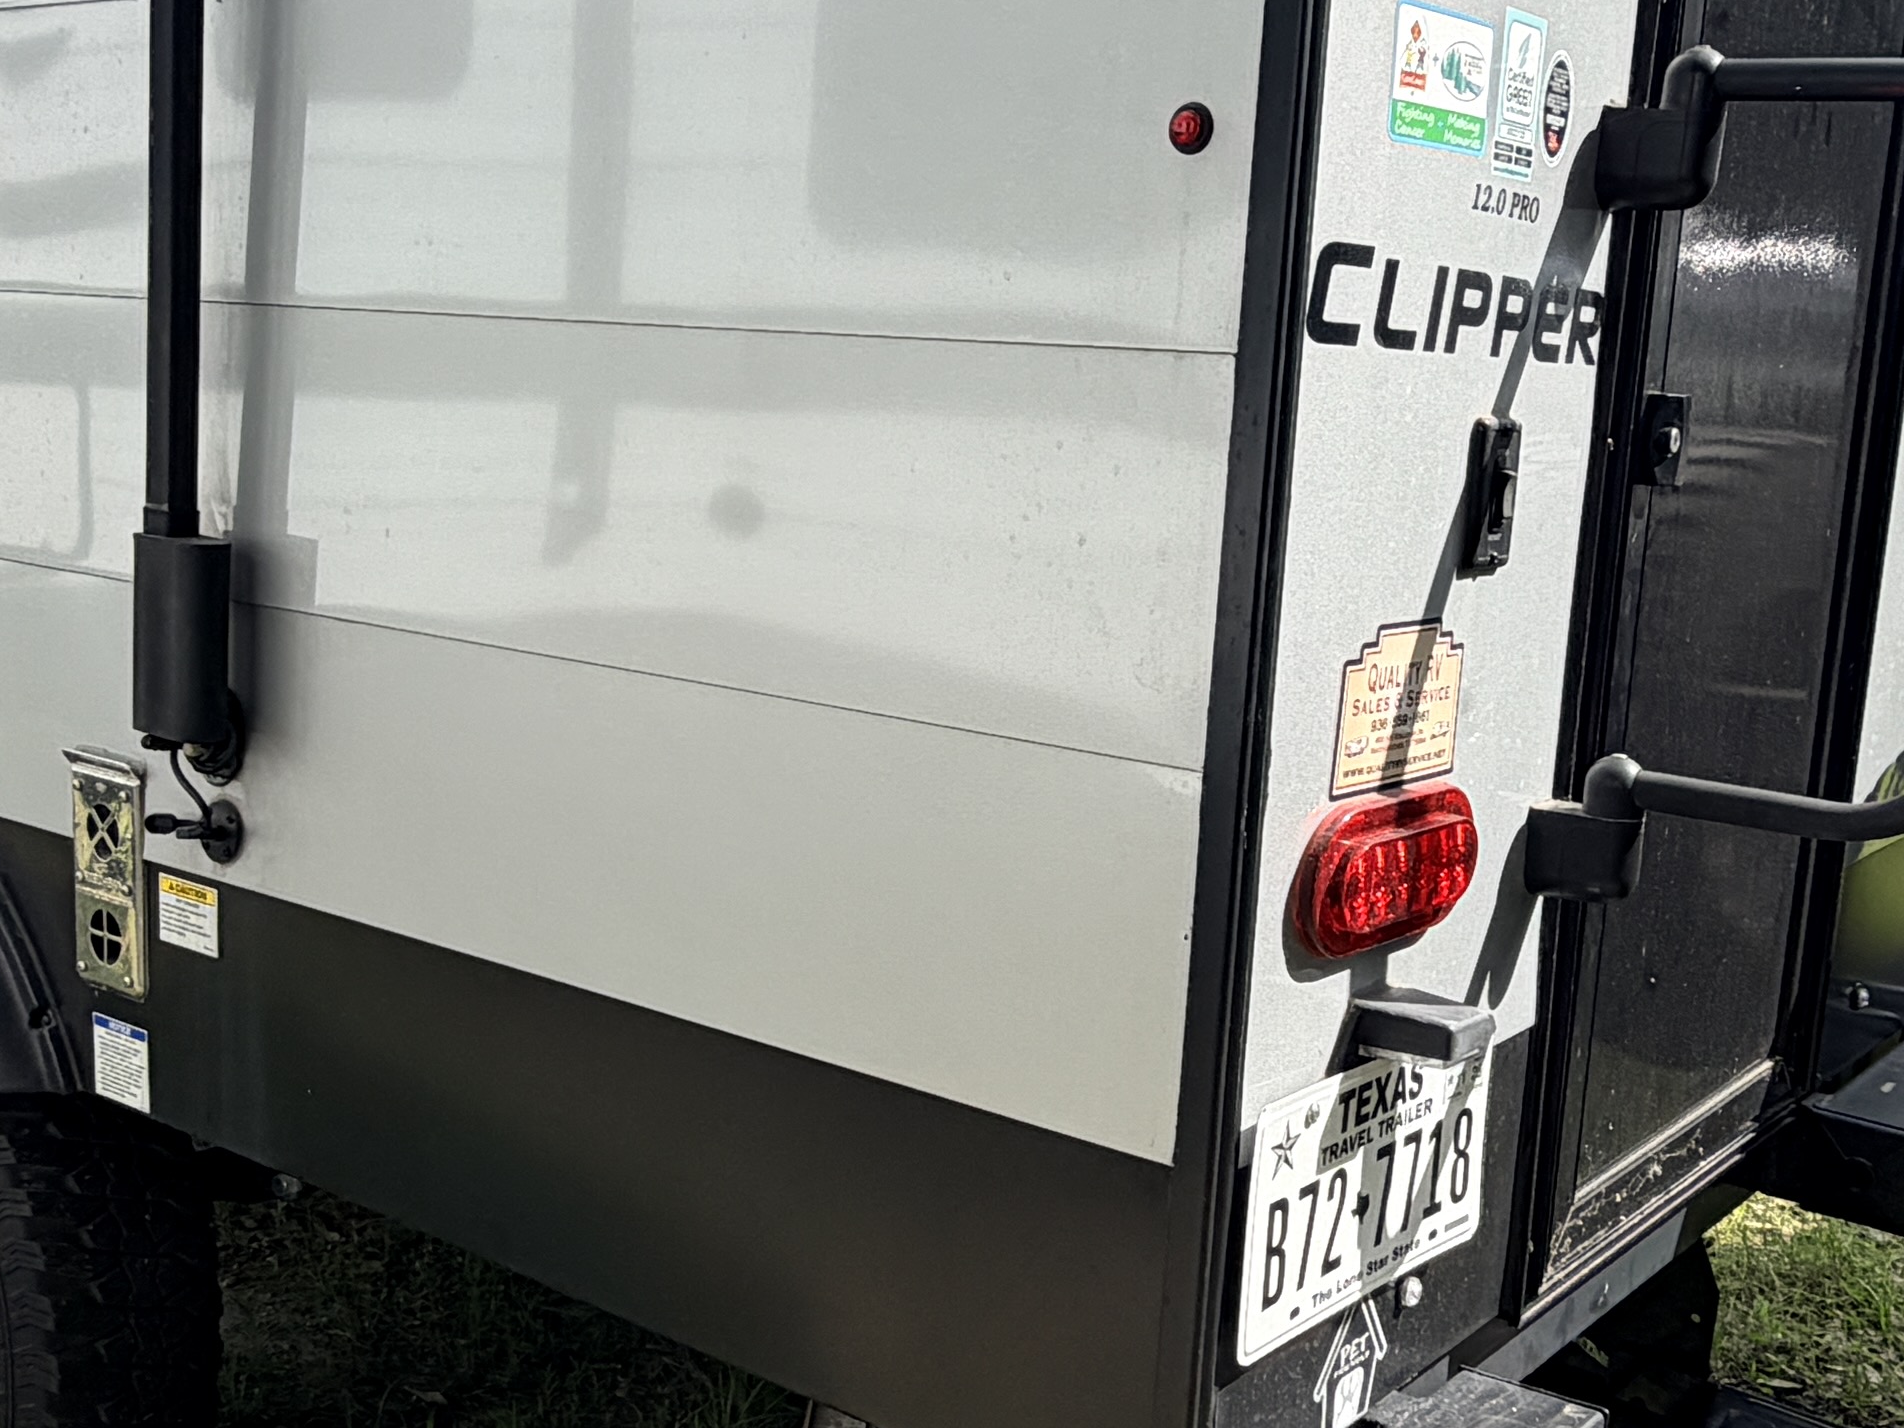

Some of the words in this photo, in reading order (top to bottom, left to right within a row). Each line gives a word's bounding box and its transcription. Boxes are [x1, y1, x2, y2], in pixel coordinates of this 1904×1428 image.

[1471, 183, 1507, 215] 12.0
[1508, 192, 1540, 224] PRO
[1306, 241, 1605, 366] CLIPPER
[1368, 659, 1423, 693] QUALITY
[1427, 653, 1444, 683] RV
[1351, 696, 1390, 717] SALES
[1406, 685, 1451, 708] SERVICE
[1338, 1063, 1424, 1134] TEXAS
[1320, 1129, 1374, 1167] TRAVEL
[1378, 1098, 1434, 1138] TRAILER
[1366, 1254, 1389, 1277] Star
[1392, 1239, 1421, 1262] State
[1340, 1332, 1370, 1369] PET
